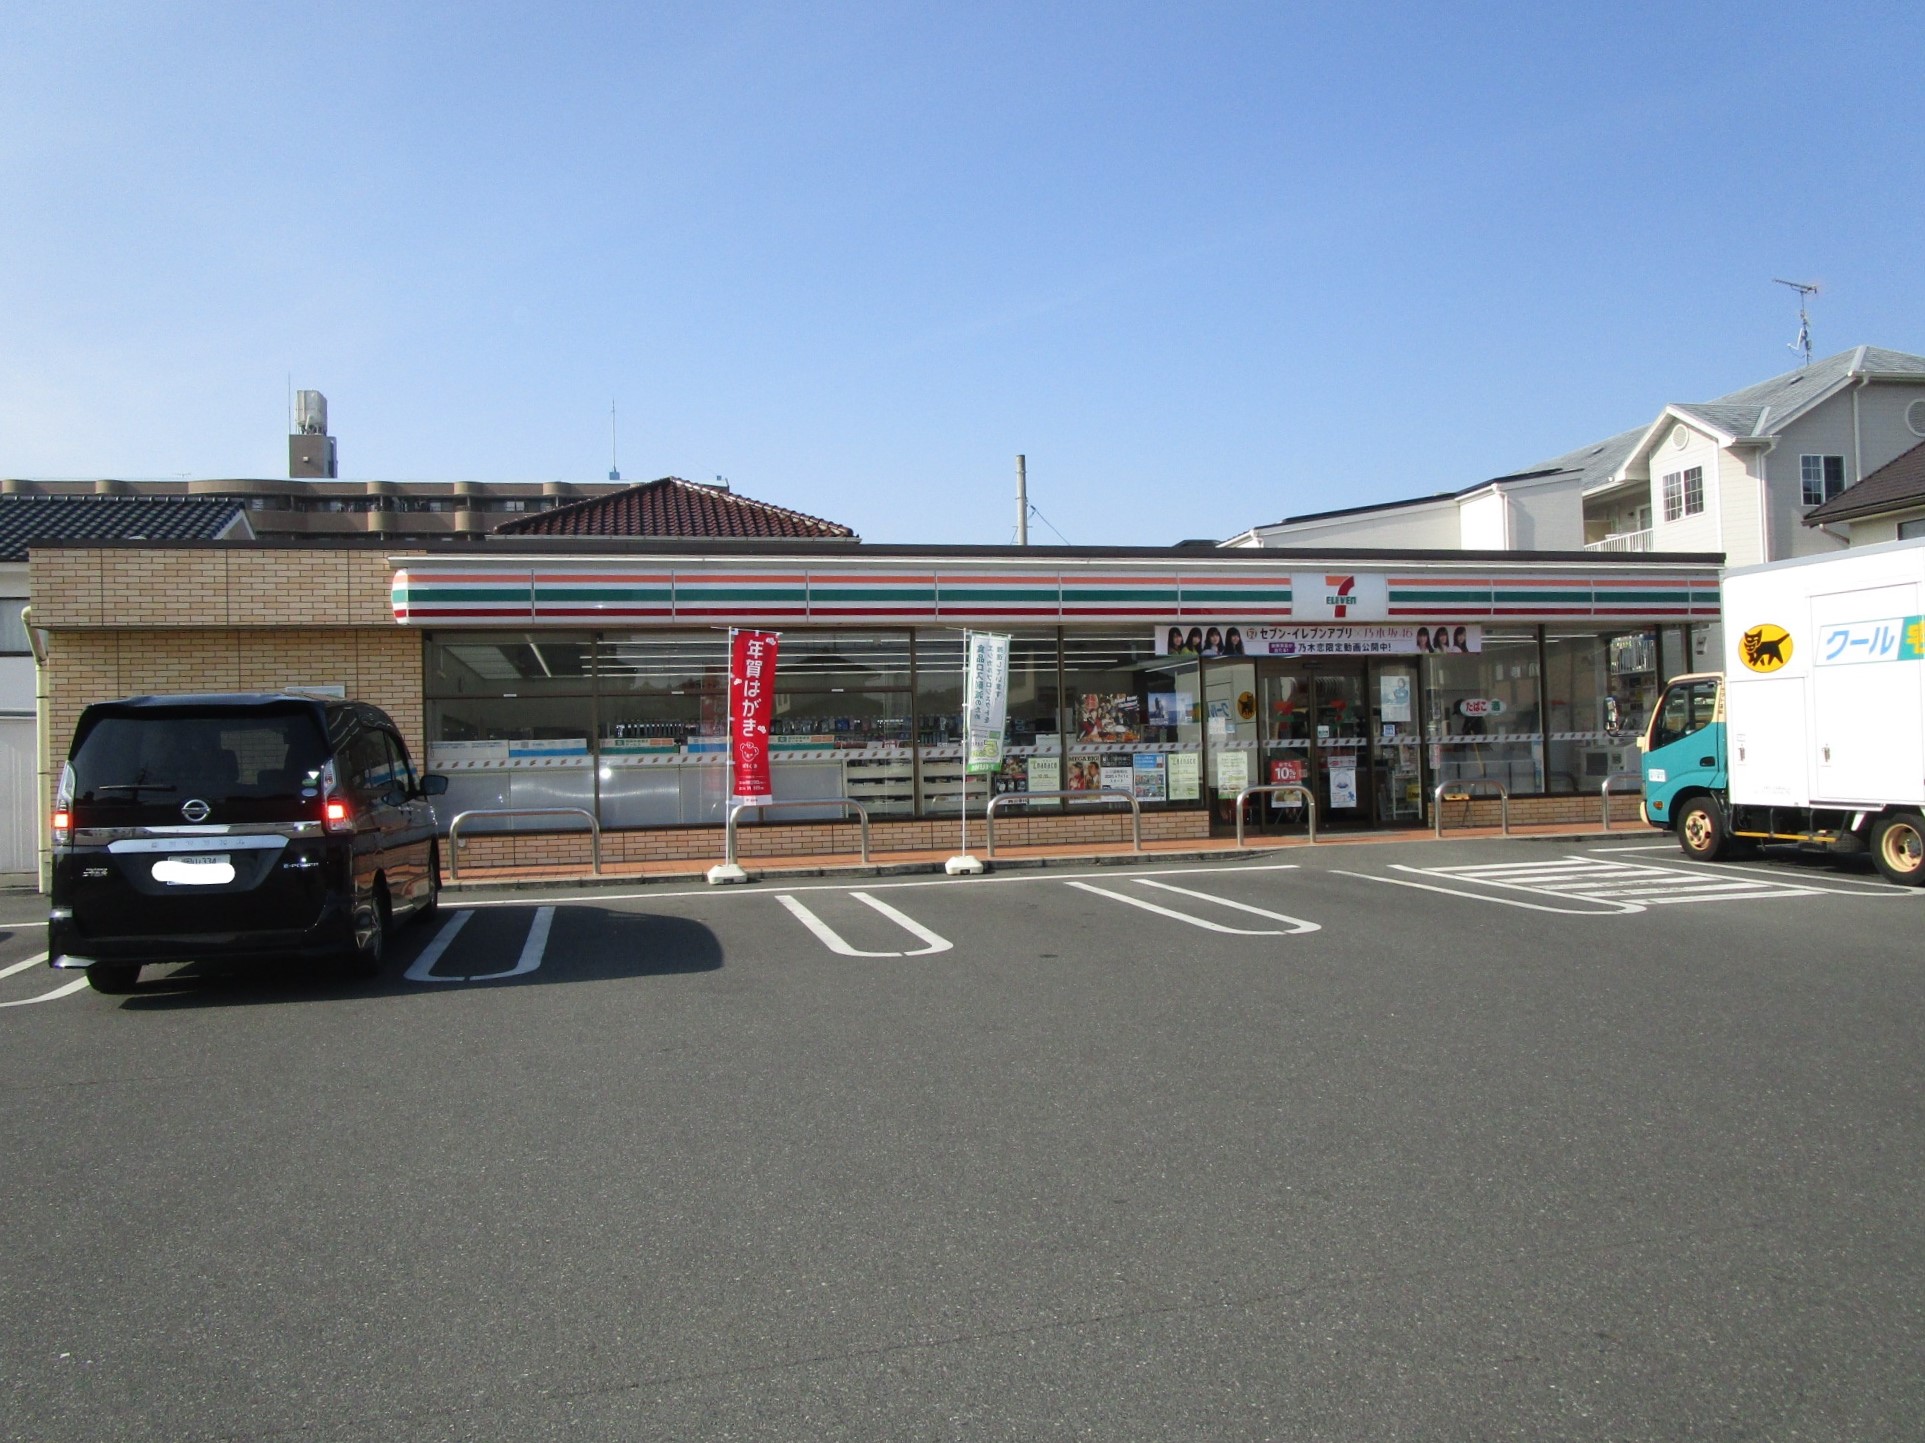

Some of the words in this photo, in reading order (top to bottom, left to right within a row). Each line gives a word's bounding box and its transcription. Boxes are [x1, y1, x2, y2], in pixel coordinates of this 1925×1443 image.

[1260, 628, 1352, 640] セブン-イレブンアプリ
[742, 639, 764, 737] 年賀はがき
[1466, 701, 1487, 712] たばこ
